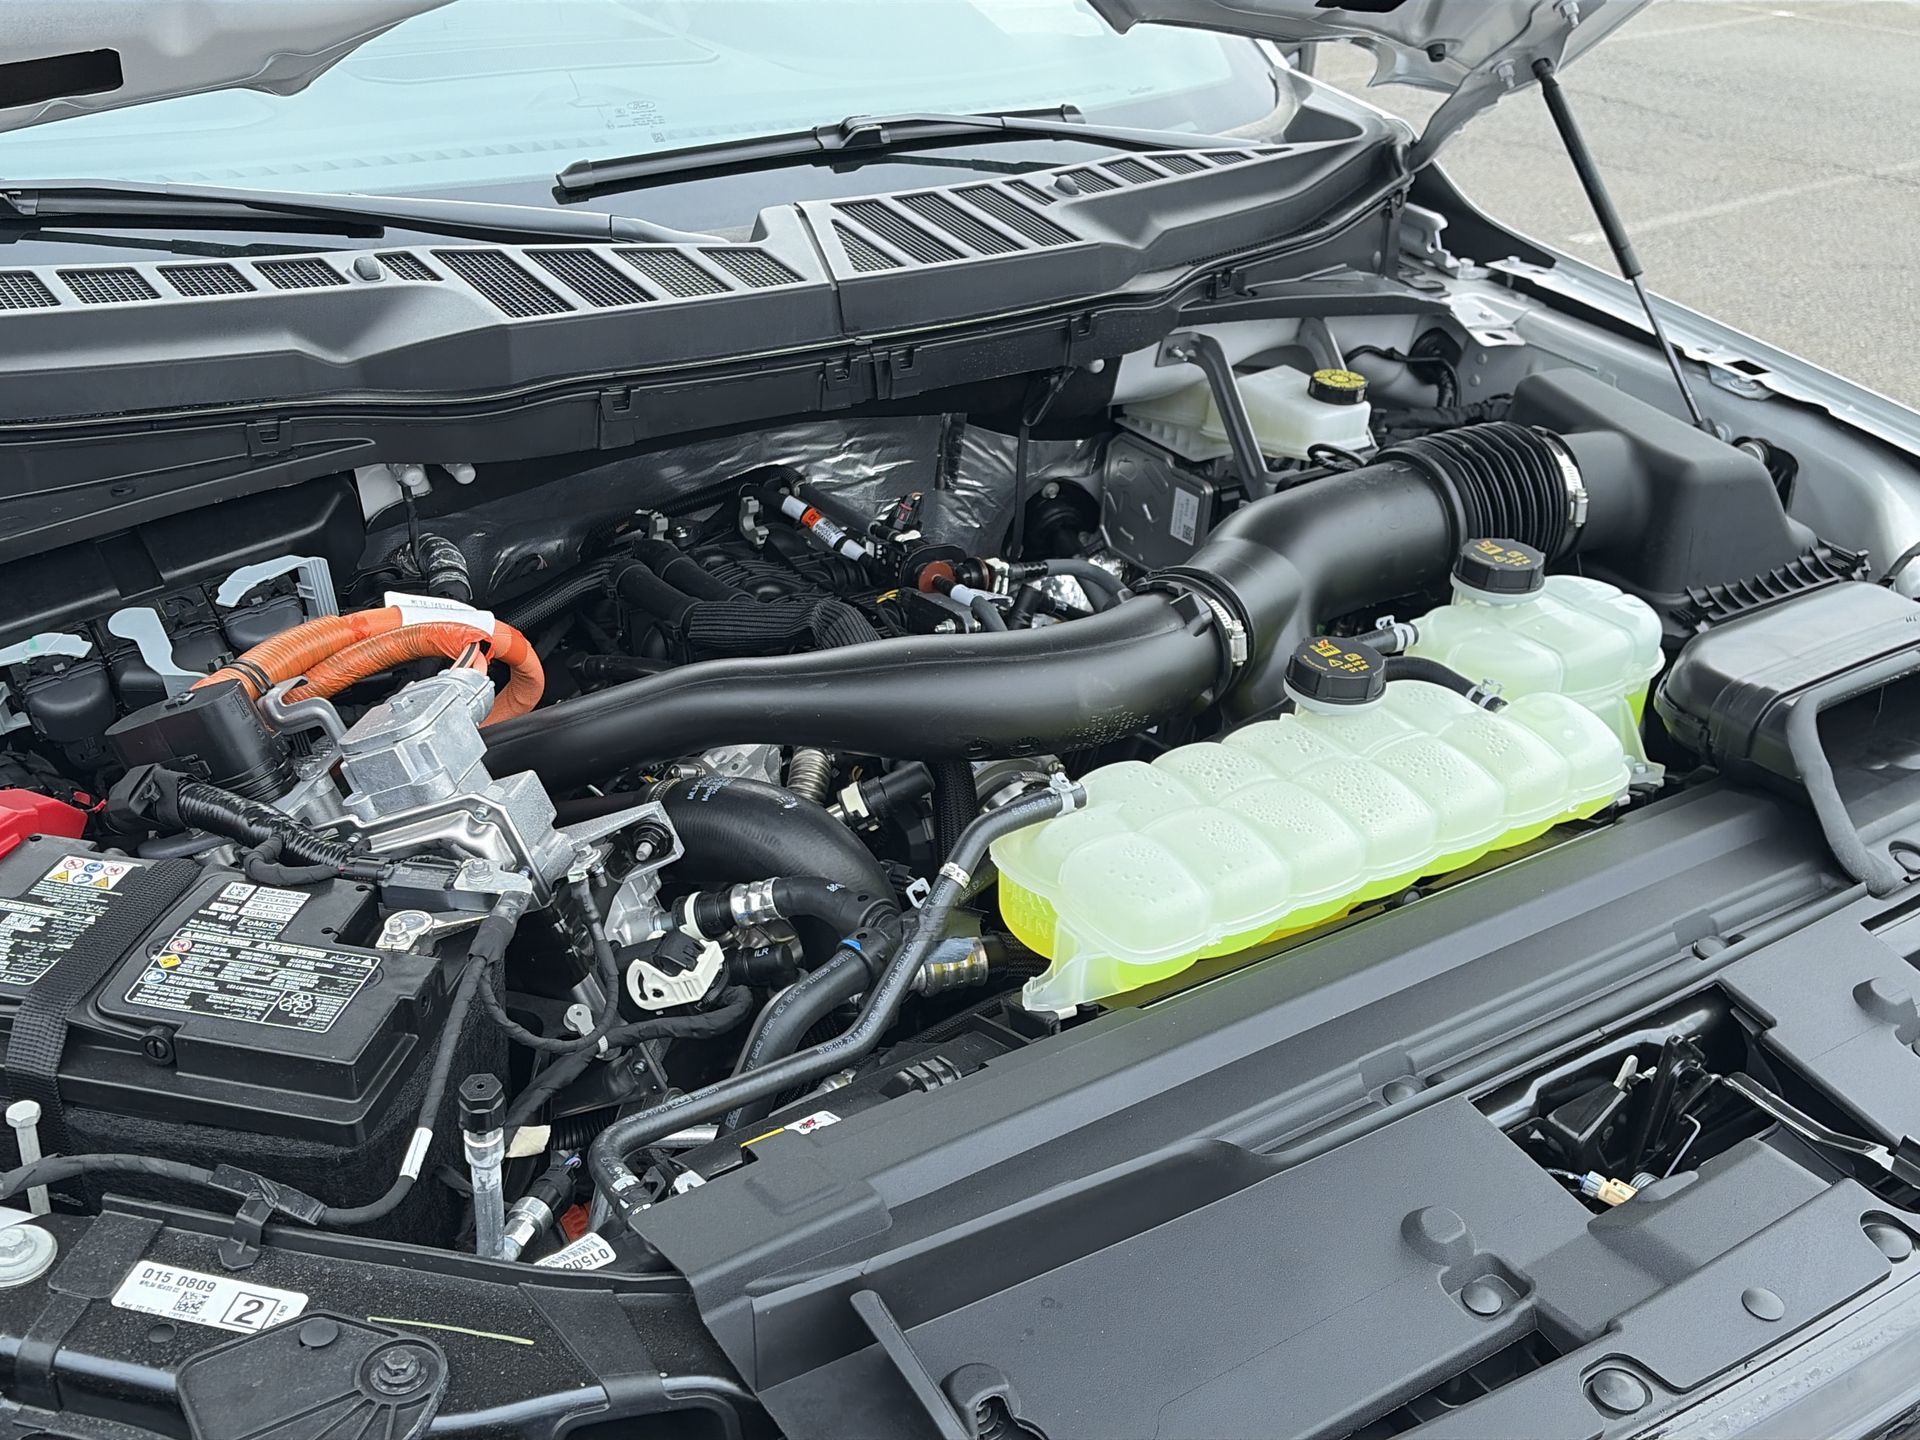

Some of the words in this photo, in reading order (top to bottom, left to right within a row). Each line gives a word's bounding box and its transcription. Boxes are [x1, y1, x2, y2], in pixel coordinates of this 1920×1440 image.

[218, 913, 239, 922] MF
[240, 918, 284, 930] FoMoCo
[142, 1267, 174, 1284] 015
[176, 1275, 217, 1293] 0809
[233, 1299, 265, 1325] 2
